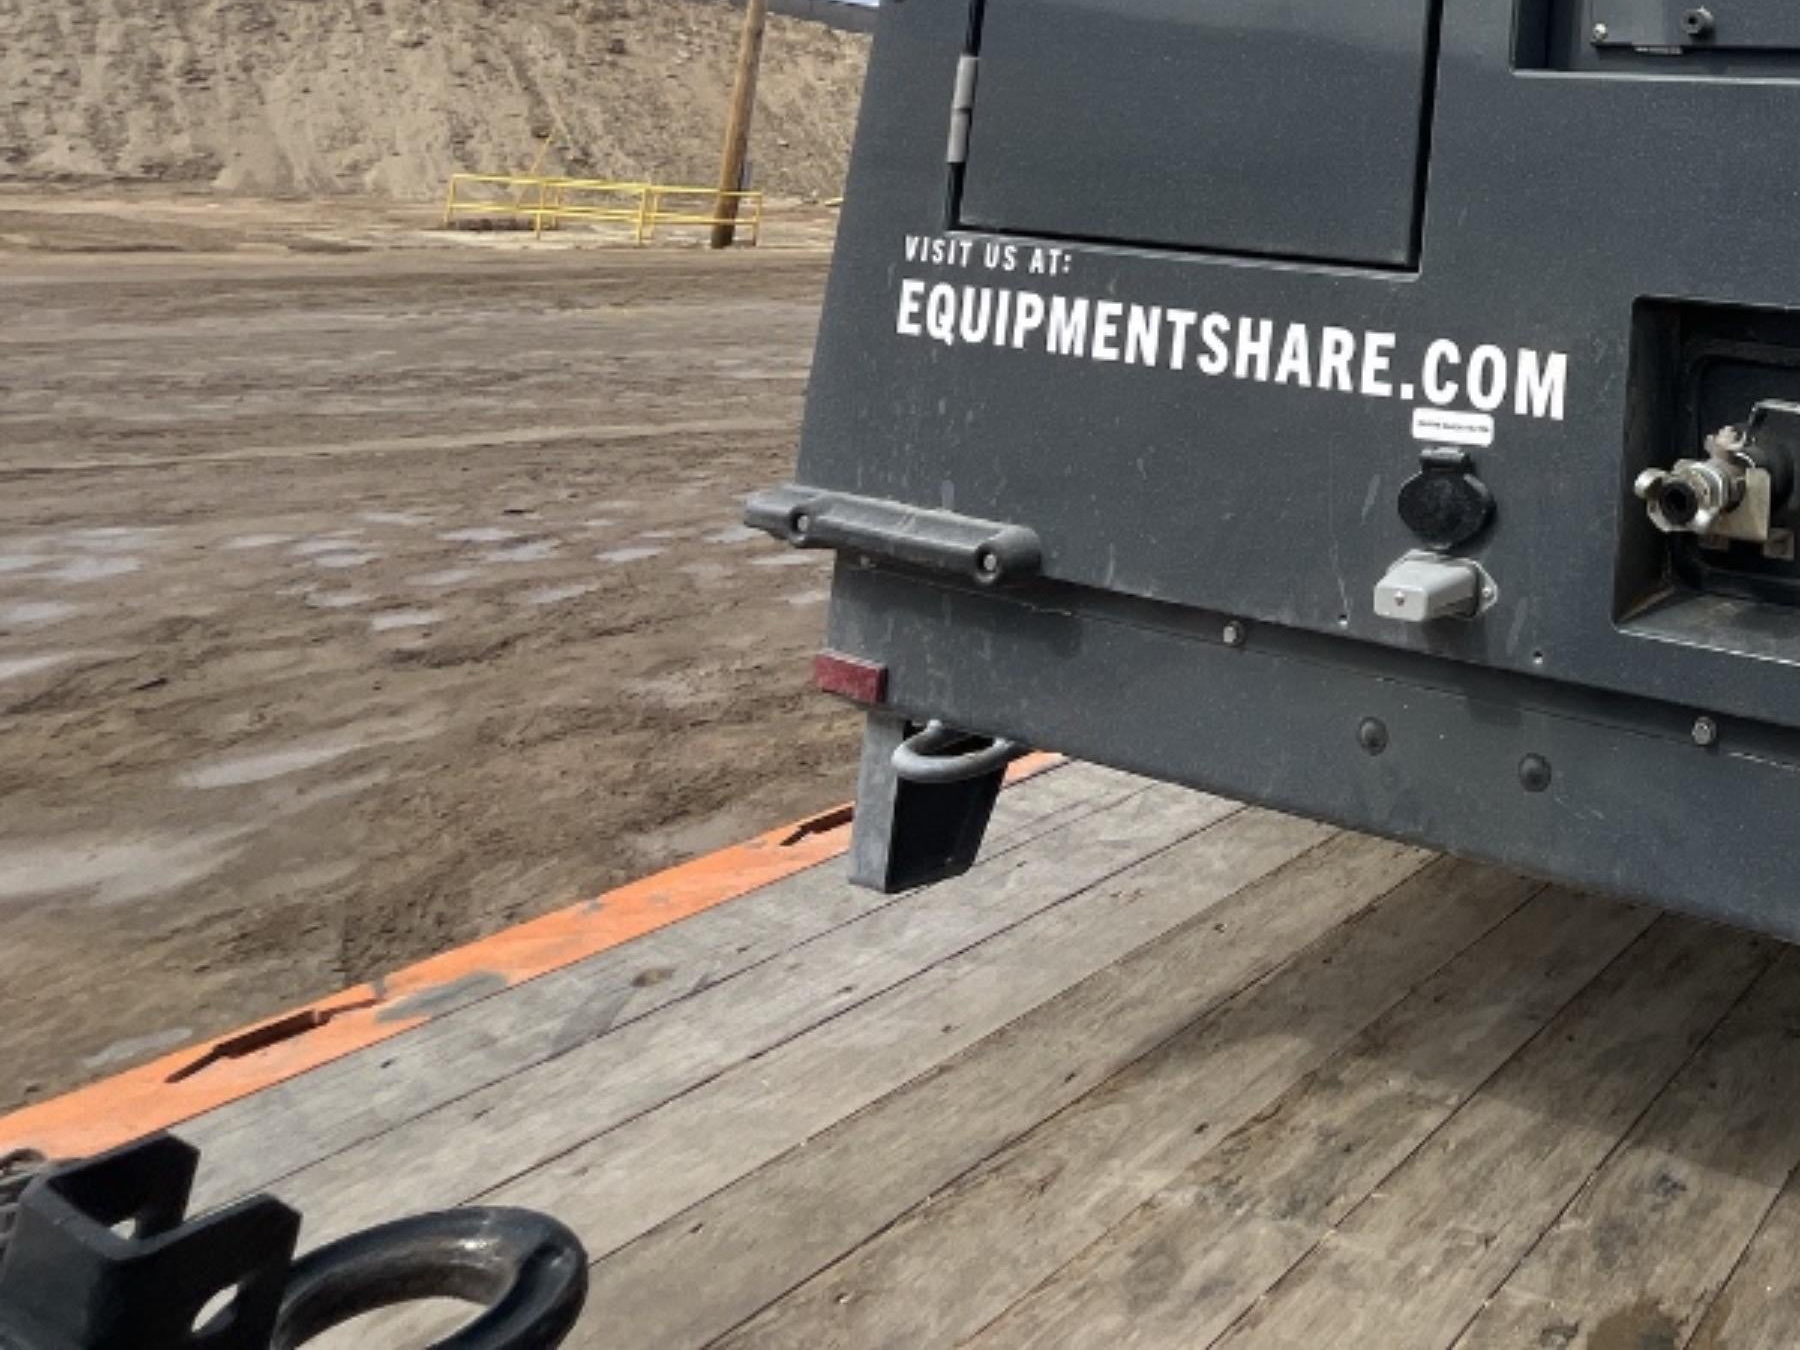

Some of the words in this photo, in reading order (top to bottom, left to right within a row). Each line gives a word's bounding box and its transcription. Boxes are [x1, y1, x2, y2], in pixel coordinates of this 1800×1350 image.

[904, 234, 973, 268] VISIT
[983, 244, 1018, 272] US
[1028, 247, 1073, 276] AT:
[896, 278, 1571, 422] EQUIPMENTSHARE.COM
